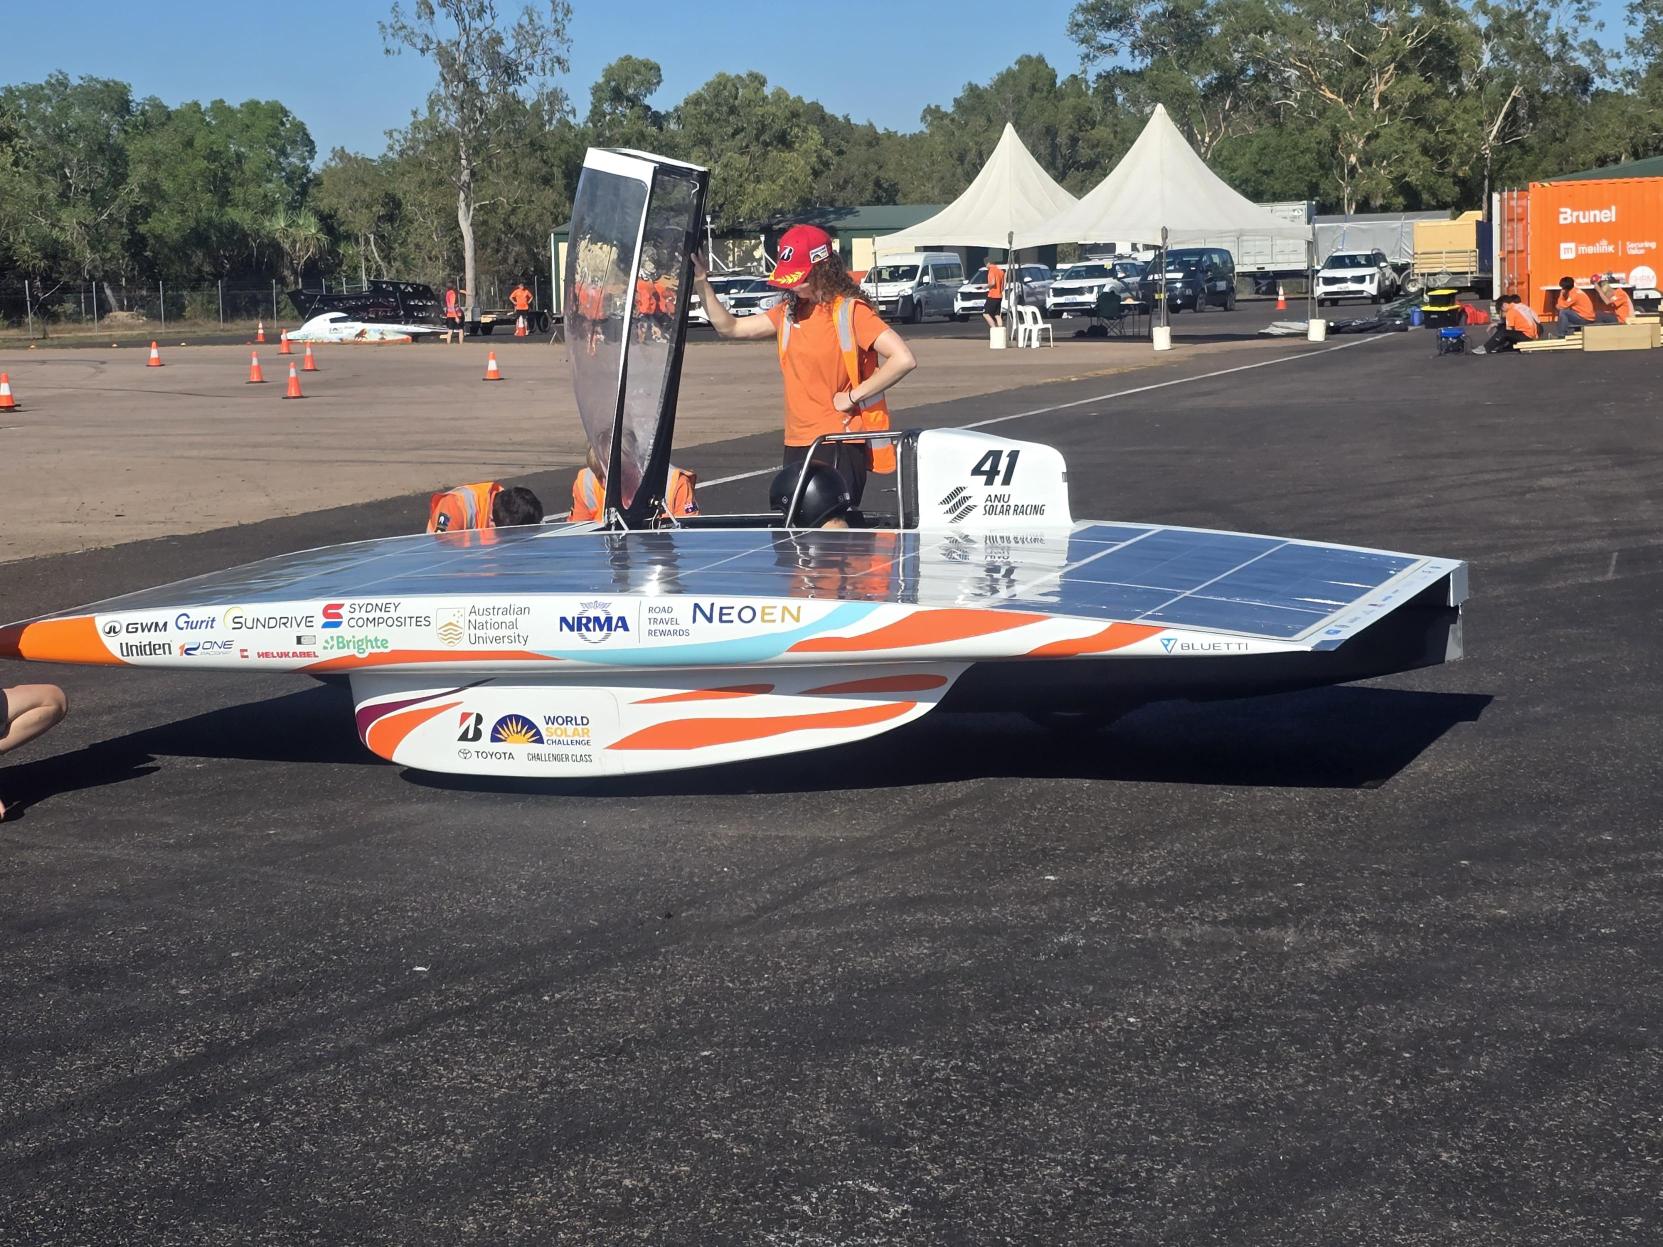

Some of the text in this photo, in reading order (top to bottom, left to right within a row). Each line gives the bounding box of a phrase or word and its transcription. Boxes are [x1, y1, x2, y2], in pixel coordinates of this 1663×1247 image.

[1559, 205, 1616, 224] Brunel
[970, 449, 1020, 486] 41
[984, 493, 1011, 503] ANU
[982, 504, 1046, 516] SOLAR RACING
[348, 602, 401, 613] SYDNEY
[468, 603, 531, 617] Australian
[648, 606, 674, 614] ROAD
[692, 602, 801, 624] NEOEN
[175, 612, 216, 630] Gurit
[231, 615, 315, 630] SUNDRIVE
[347, 615, 431, 628] COMPOSITES
[468, 617, 519, 630] National
[559, 615, 630, 632] NRMA
[648, 617, 680, 626] TRAVEL
[125, 621, 168, 634] GWM
[647, 628, 690, 637] REWARDS
[336, 635, 389, 654] Brighte
[468, 631, 529, 646] University
[120, 640, 172, 657] Uniden
[201, 640, 235, 650] ONE
[1180, 642, 1248, 651] BLUETTI
[256, 651, 319, 659] HELUKABEL
[543, 715, 590, 726] WORLD
[545, 726, 590, 737] SOLAR
[474, 750, 515, 760] TOYOTA
[527, 752, 593, 763] CHALLENGER CLASS
